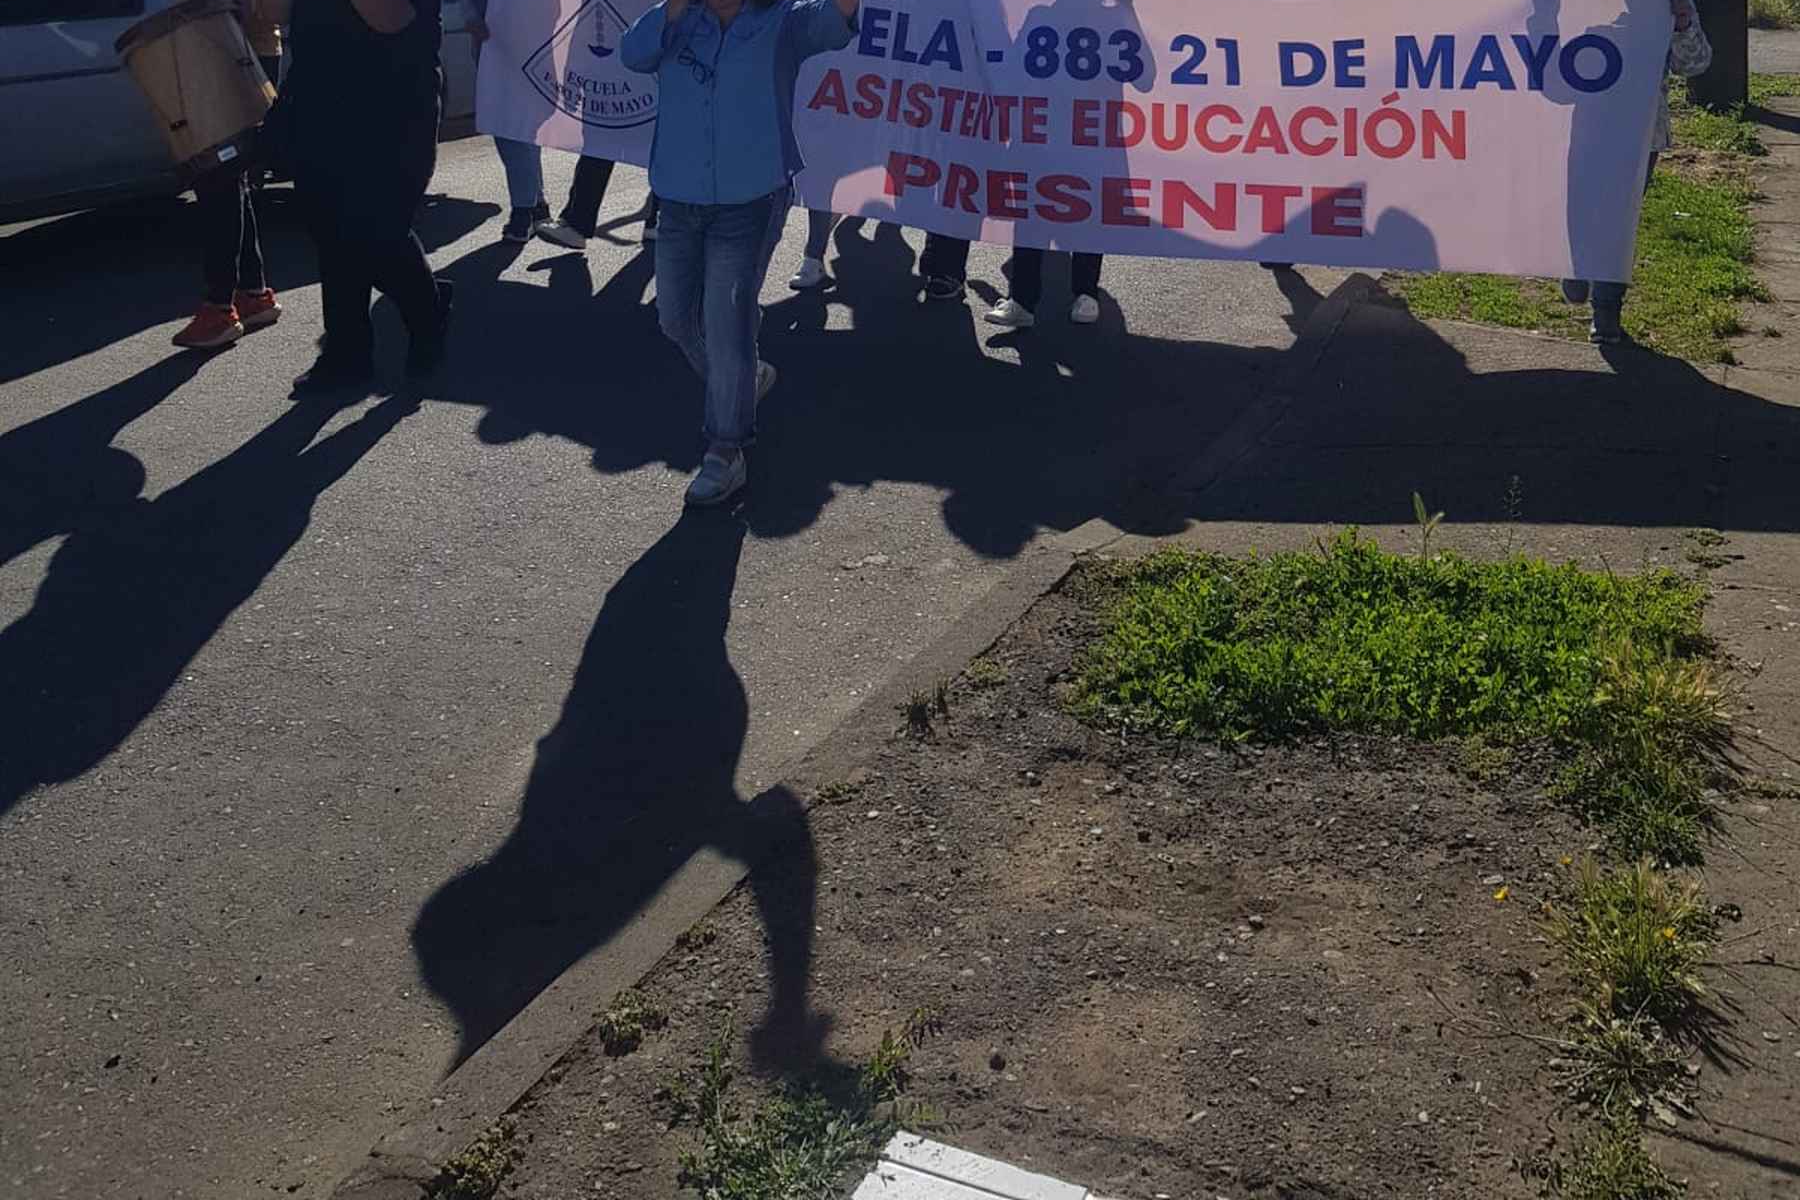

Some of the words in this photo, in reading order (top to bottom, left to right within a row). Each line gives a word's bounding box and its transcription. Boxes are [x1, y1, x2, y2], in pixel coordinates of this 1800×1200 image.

[567, 71, 632, 96] ESCUELA
[857, 7, 964, 72] ELA
[1024, 26, 1145, 83] 883
[1170, 34, 1241, 87] 21
[1278, 38, 1366, 88] DE
[1395, 33, 1623, 93] MAYO
[611, 93, 654, 114] MAYO
[807, 68, 1049, 145] ASISTENTE
[1072, 91, 1467, 161] EDUCACIÓN
[883, 151, 1364, 238] PRESENTE
